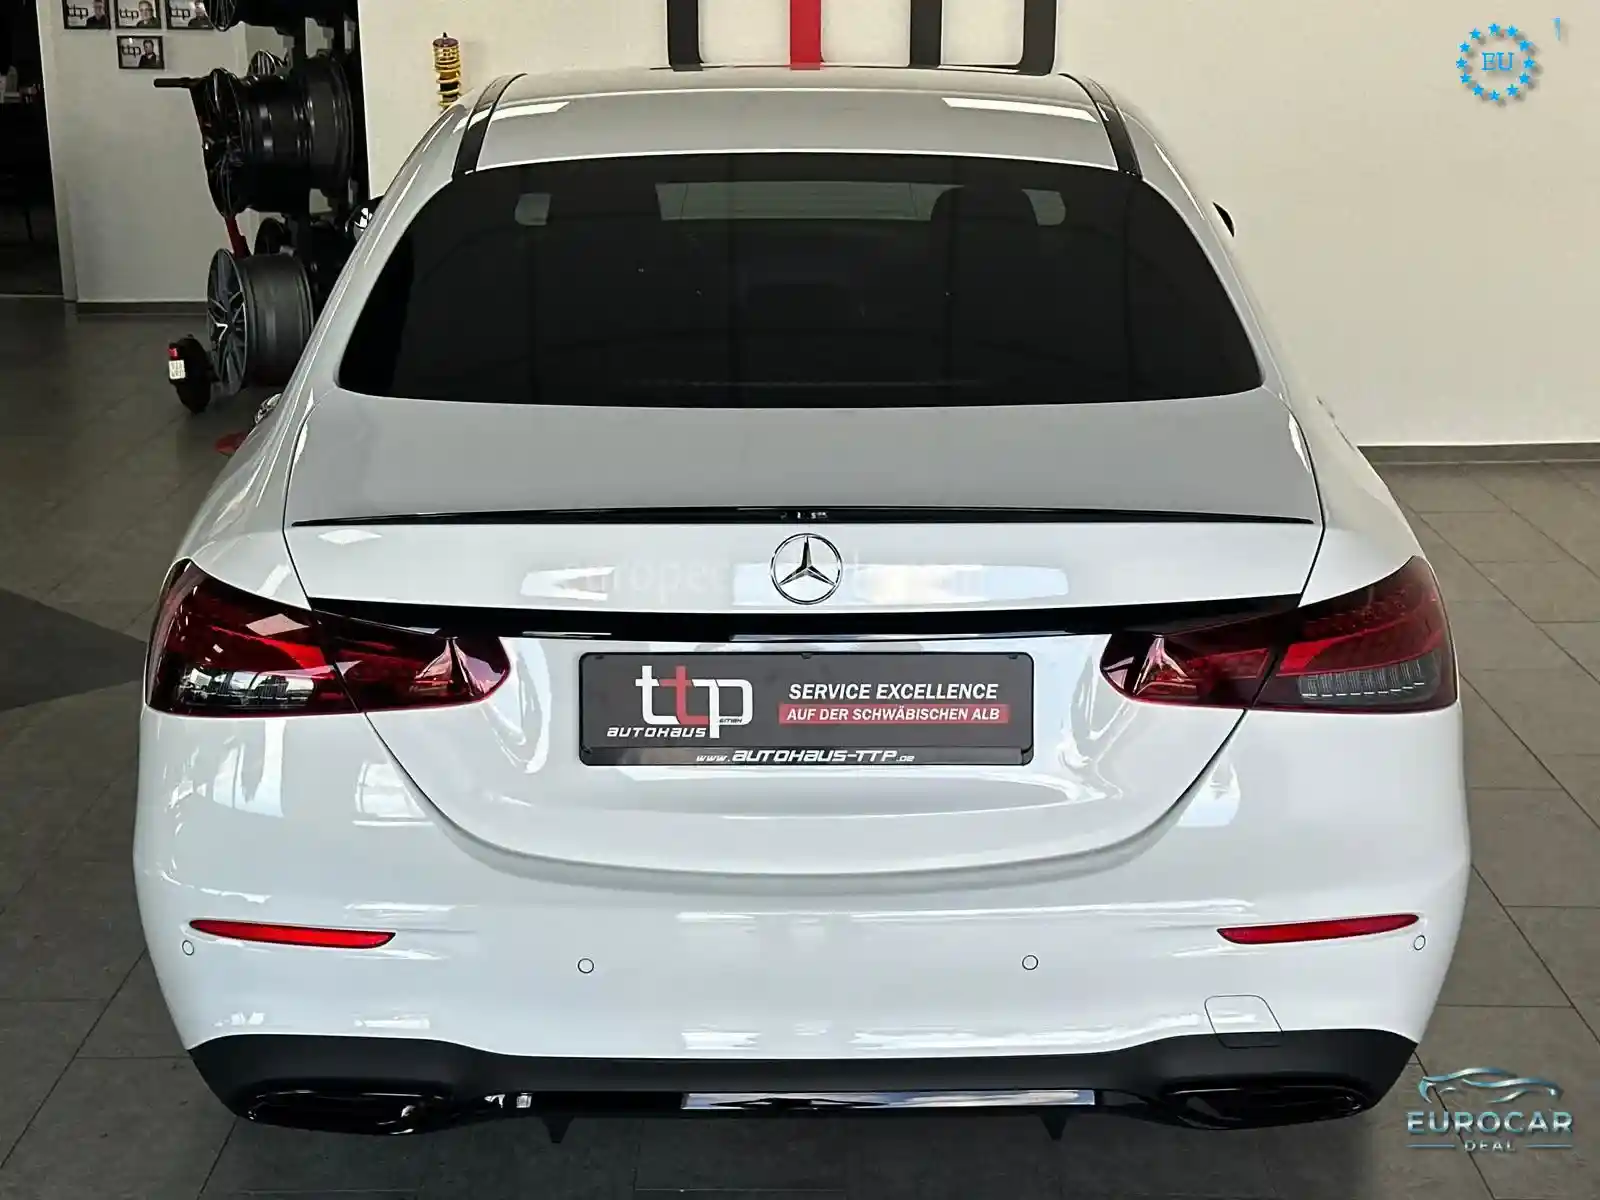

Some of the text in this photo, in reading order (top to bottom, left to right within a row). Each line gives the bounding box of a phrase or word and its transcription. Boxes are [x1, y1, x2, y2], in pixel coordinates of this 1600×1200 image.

[788, 683, 999, 700] SERVICE EXCELLENCE
[635, 665, 753, 739] ttp
[786, 705, 1001, 721] AUF DER SCHWÄBISCHEN ALB
